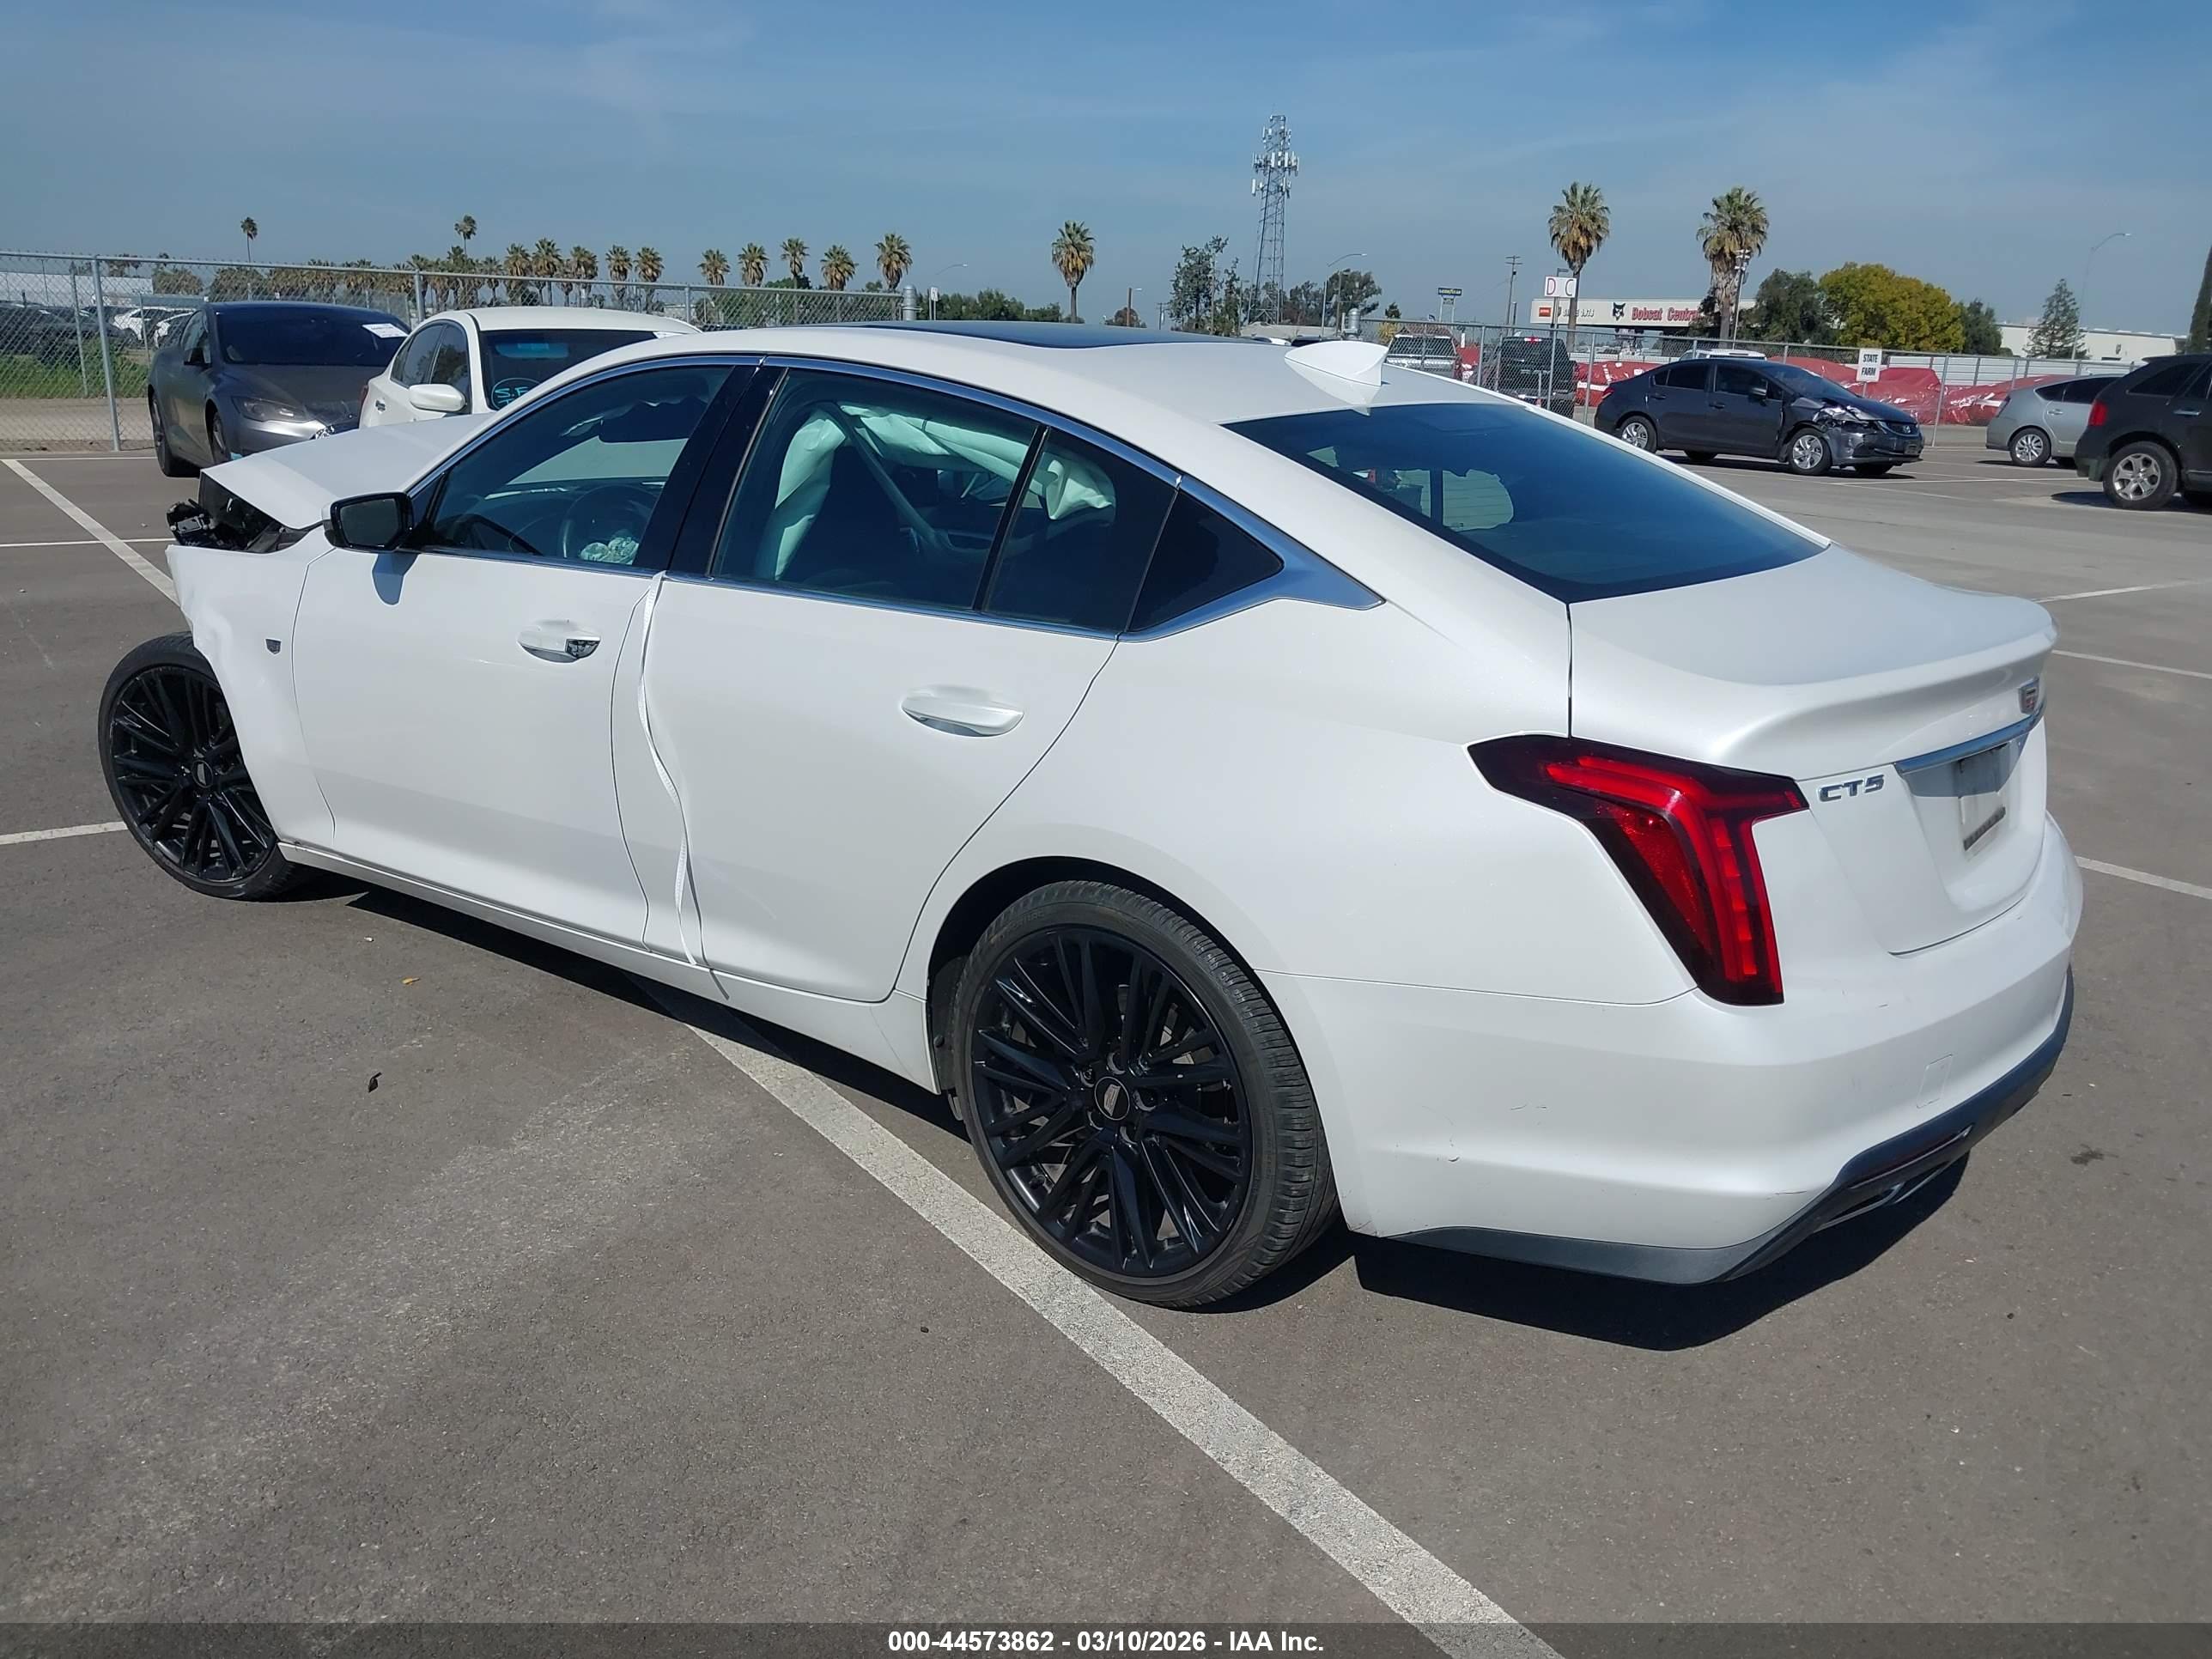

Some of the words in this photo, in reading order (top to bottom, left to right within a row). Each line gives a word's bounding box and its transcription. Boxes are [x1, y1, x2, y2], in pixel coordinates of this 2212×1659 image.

[1547, 277, 1557, 295] D
[1565, 279, 1574, 296] C
[1563, 308, 1580, 317] SIE
[1632, 307, 1662, 321] Bobcat
[1863, 354, 1878, 363] STATE
[1861, 367, 1876, 375] FARM
[1819, 774, 1885, 802] CT5
